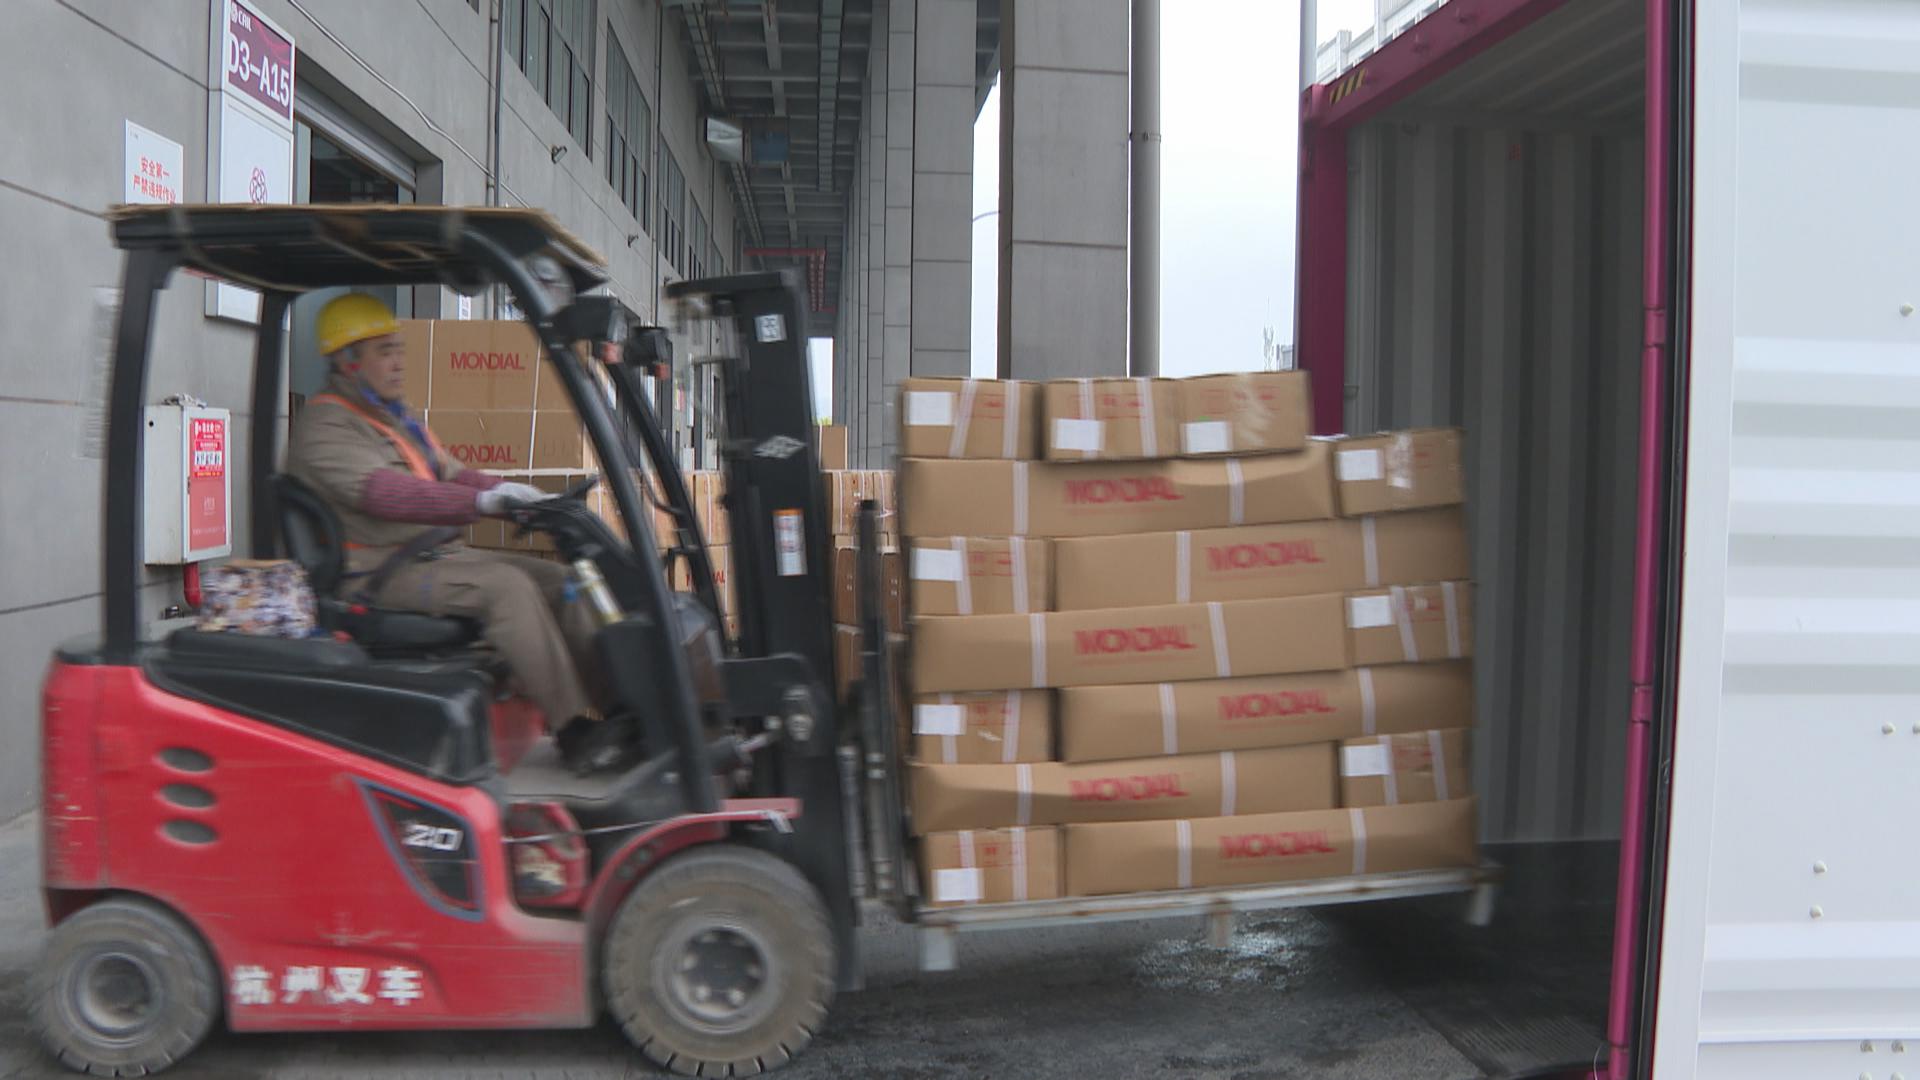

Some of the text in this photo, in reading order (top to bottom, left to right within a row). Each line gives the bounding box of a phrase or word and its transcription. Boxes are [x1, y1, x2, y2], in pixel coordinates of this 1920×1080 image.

[228, 32, 290, 107] D3-A15
[450, 352, 526, 370] MONDIAL
[402, 824, 464, 851] 20
